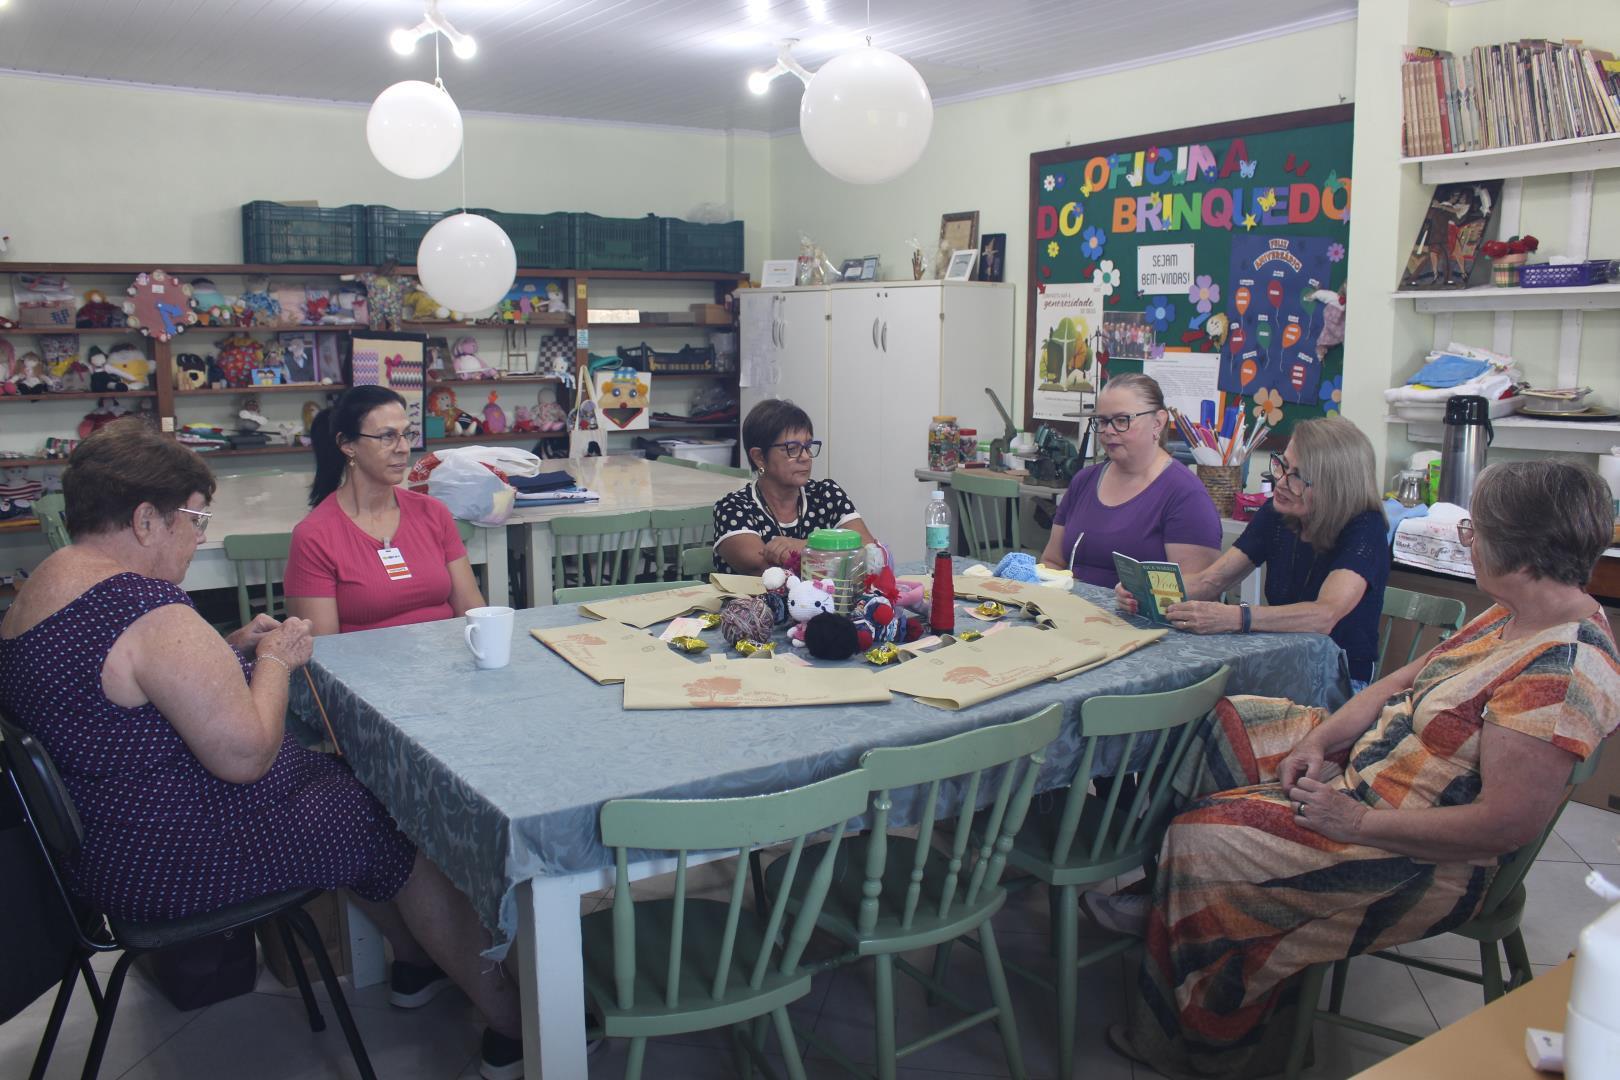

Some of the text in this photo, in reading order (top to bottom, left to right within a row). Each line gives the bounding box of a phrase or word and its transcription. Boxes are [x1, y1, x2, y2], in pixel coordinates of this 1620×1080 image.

[1084, 138, 1249, 192] OFICINA
[1037, 178, 1353, 239] DO BRINQUEDO
[1152, 254, 1178, 267] SEJAM
[1141, 272, 1190, 286] BEM-VINDAS!
[1043, 297, 1094, 310] generosidade
